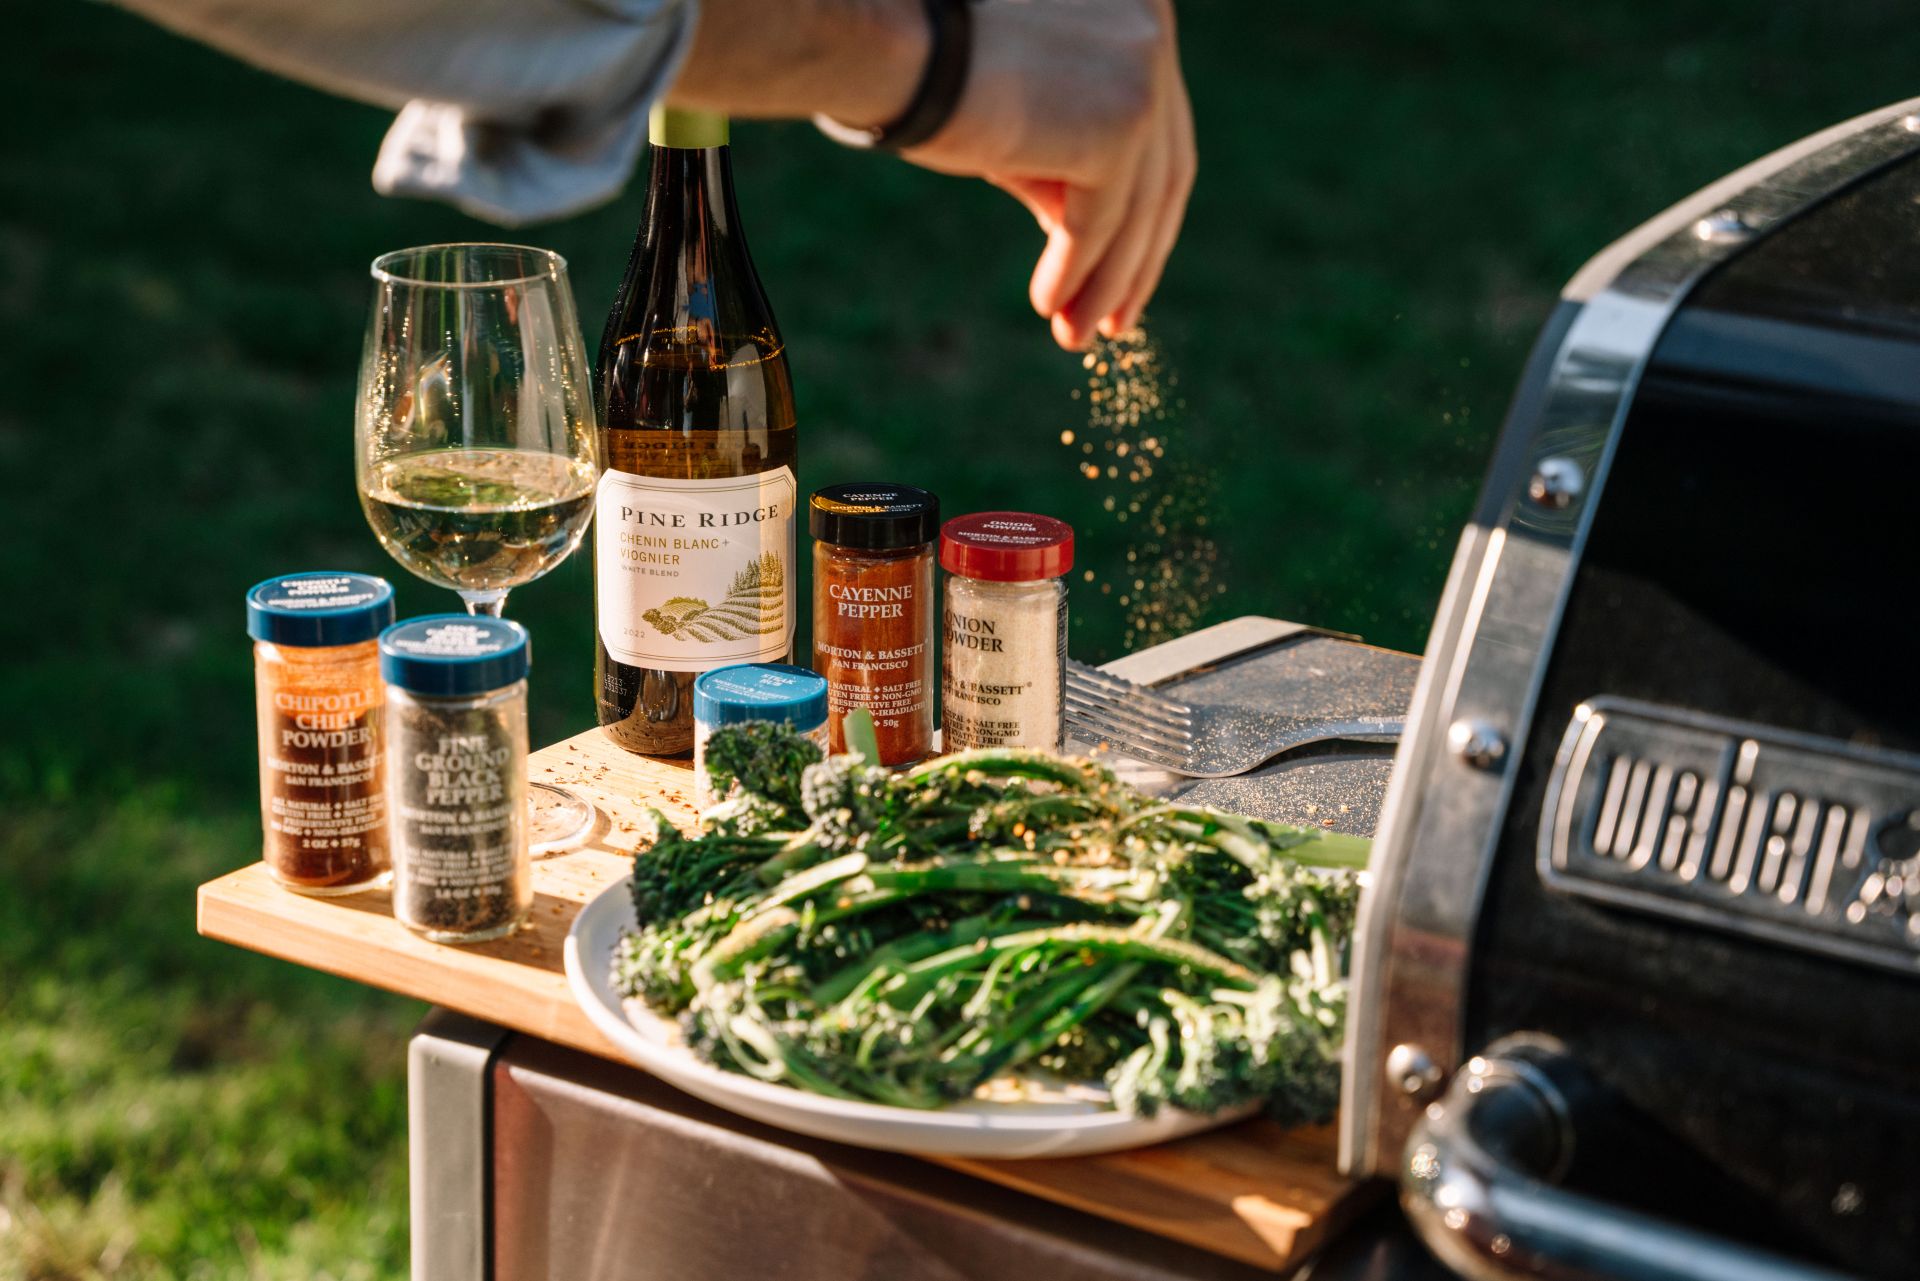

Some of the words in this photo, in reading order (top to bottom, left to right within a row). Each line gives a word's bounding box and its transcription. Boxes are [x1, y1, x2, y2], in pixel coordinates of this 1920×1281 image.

[620, 505, 686, 528] PINE
[698, 504, 778, 528] RIDGE
[982, 523, 1037, 532] POWDER
[990, 520, 1033, 528] ONION
[620, 532, 667, 549] CHENIN
[620, 549, 680, 565] VIOGNIER
[829, 584, 912, 602] CAYENNE
[837, 602, 903, 619] PEPPER
[623, 627, 646, 638] 2022
[817, 641, 861, 659] MORTON
[864, 651, 875, 660] &
[878, 643, 924, 660] BASSETT
[831, 659, 850, 669] SAN
[852, 660, 908, 671] FRANCISCO
[832, 682, 872, 693] NATURAL
[882, 684, 904, 693] SALT
[905, 679, 921, 690] FREE
[971, 682, 1025, 696] BASSETT
[275, 689, 374, 711] CHIPOTLE
[828, 689, 848, 699] UTEN
[849, 693, 872, 701] FREE
[881, 688, 922, 701] NON-GMO
[892, 698, 912, 708] FREE
[296, 712, 356, 730] CHILI
[882, 719, 900, 728] 50g
[973, 720, 996, 729] SALT
[997, 721, 1020, 729] FREE
[282, 727, 371, 748] POWDER
[973, 727, 1020, 737] NON-GMO
[982, 737, 1005, 745] FREE
[415, 747, 510, 771] GROUND
[428, 770, 500, 788] BLACK
[427, 785, 502, 805] PEPPER
